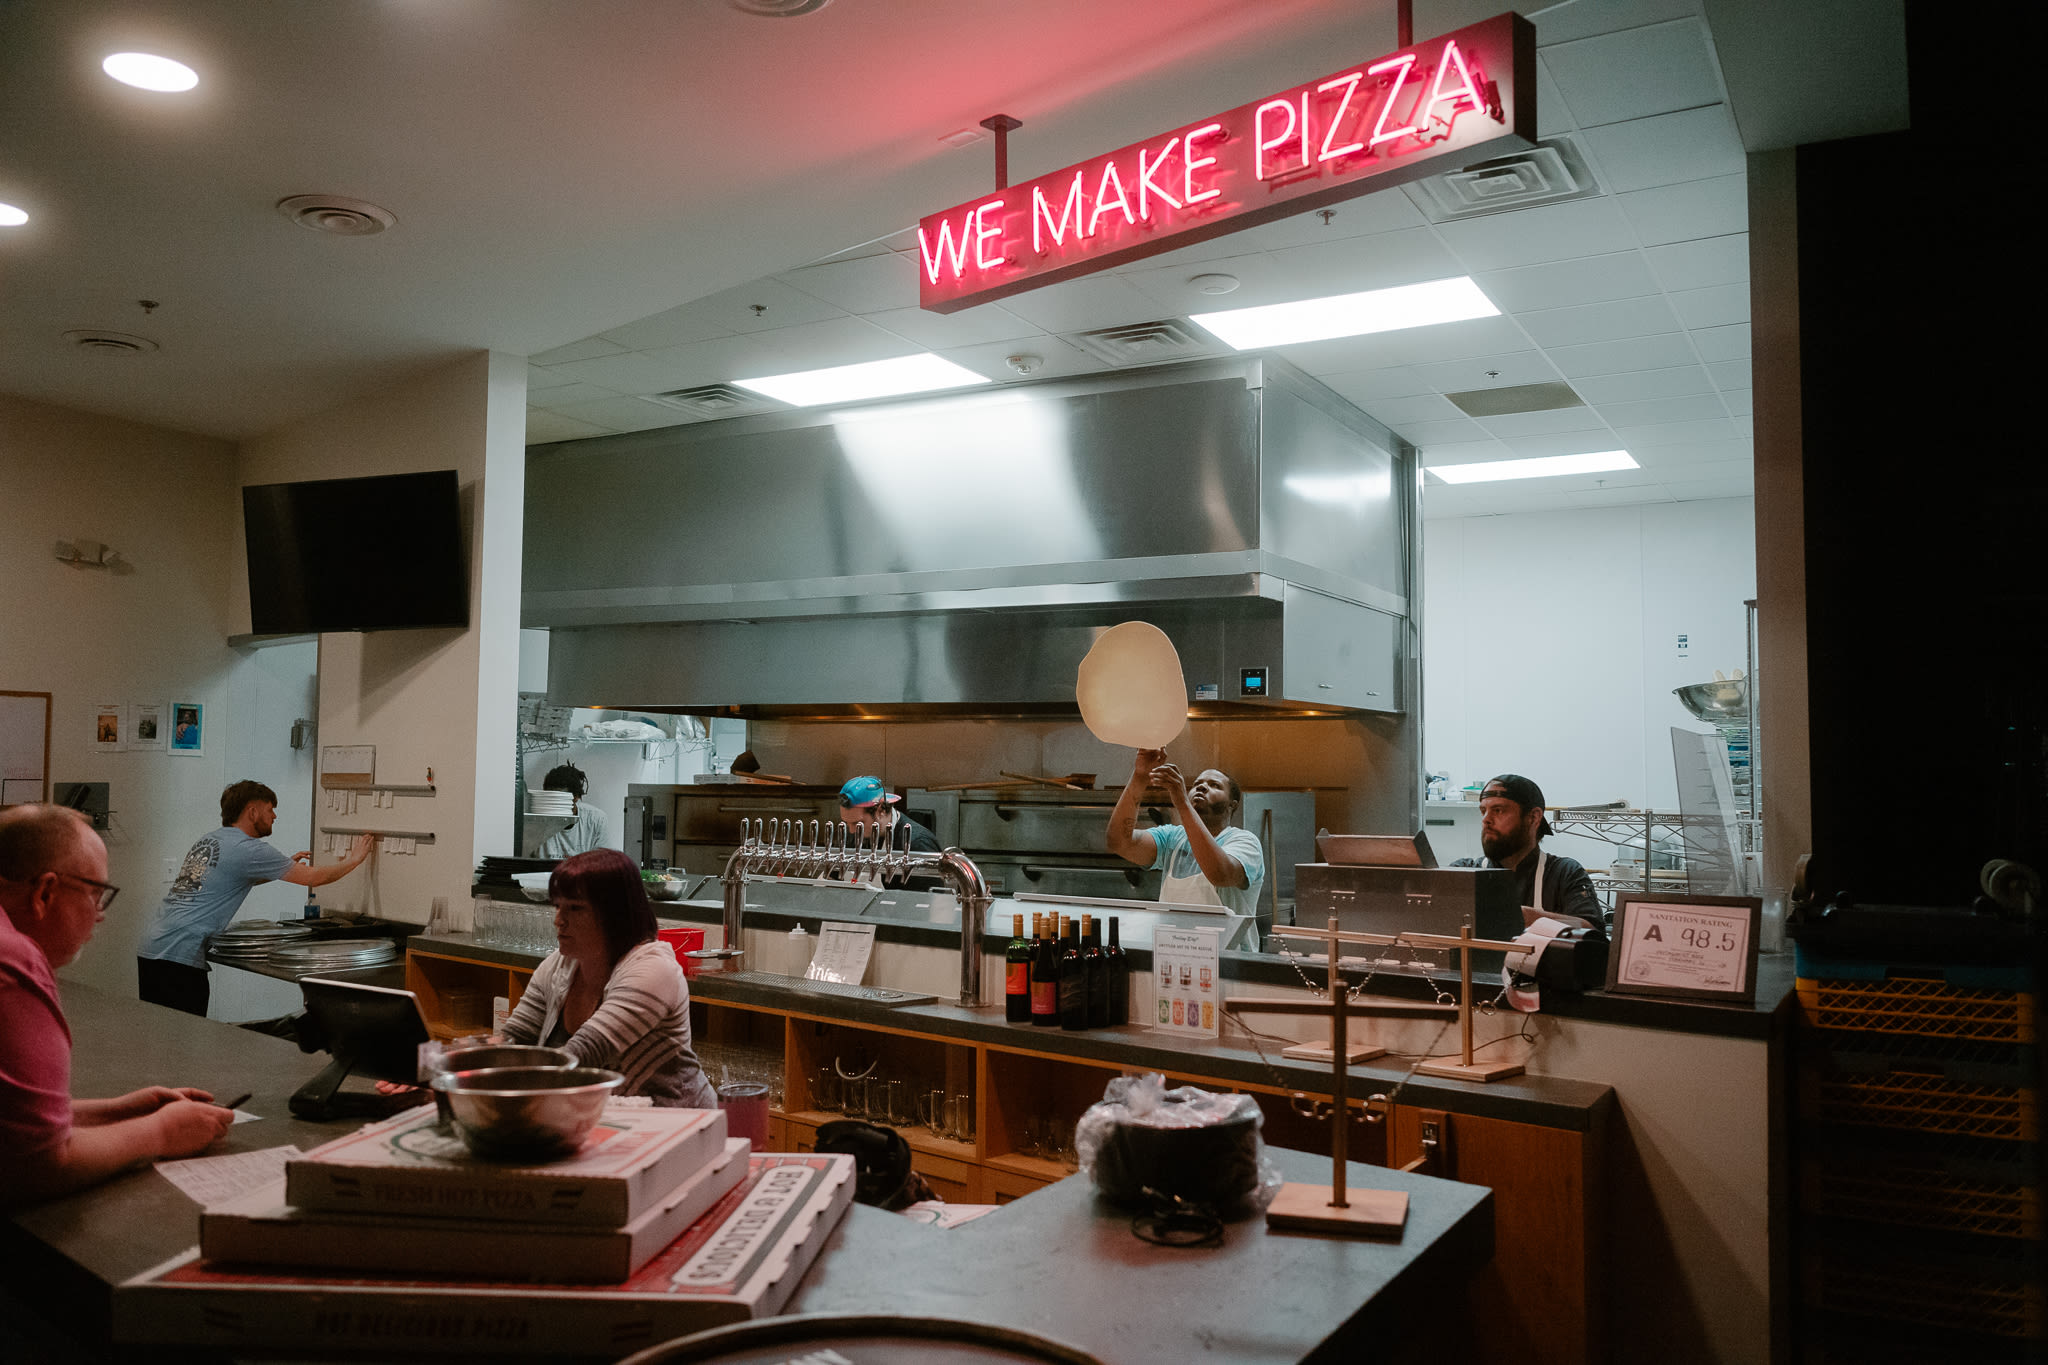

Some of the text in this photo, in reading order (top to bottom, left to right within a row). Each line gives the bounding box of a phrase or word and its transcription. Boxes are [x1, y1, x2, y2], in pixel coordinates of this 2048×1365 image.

[917, 39, 1488, 286] WE MAKE PIZZA
[1649, 912, 1733, 928] SANITATION RATING
[1643, 924, 1736, 951] A 98.5
[373, 1182, 537, 1210] FRESH HOT PIZZA
[763, 1171, 805, 1195] HOT
[687, 1209, 775, 1279] DELICIOUS
[471, 1316, 530, 1340] PIZZA
